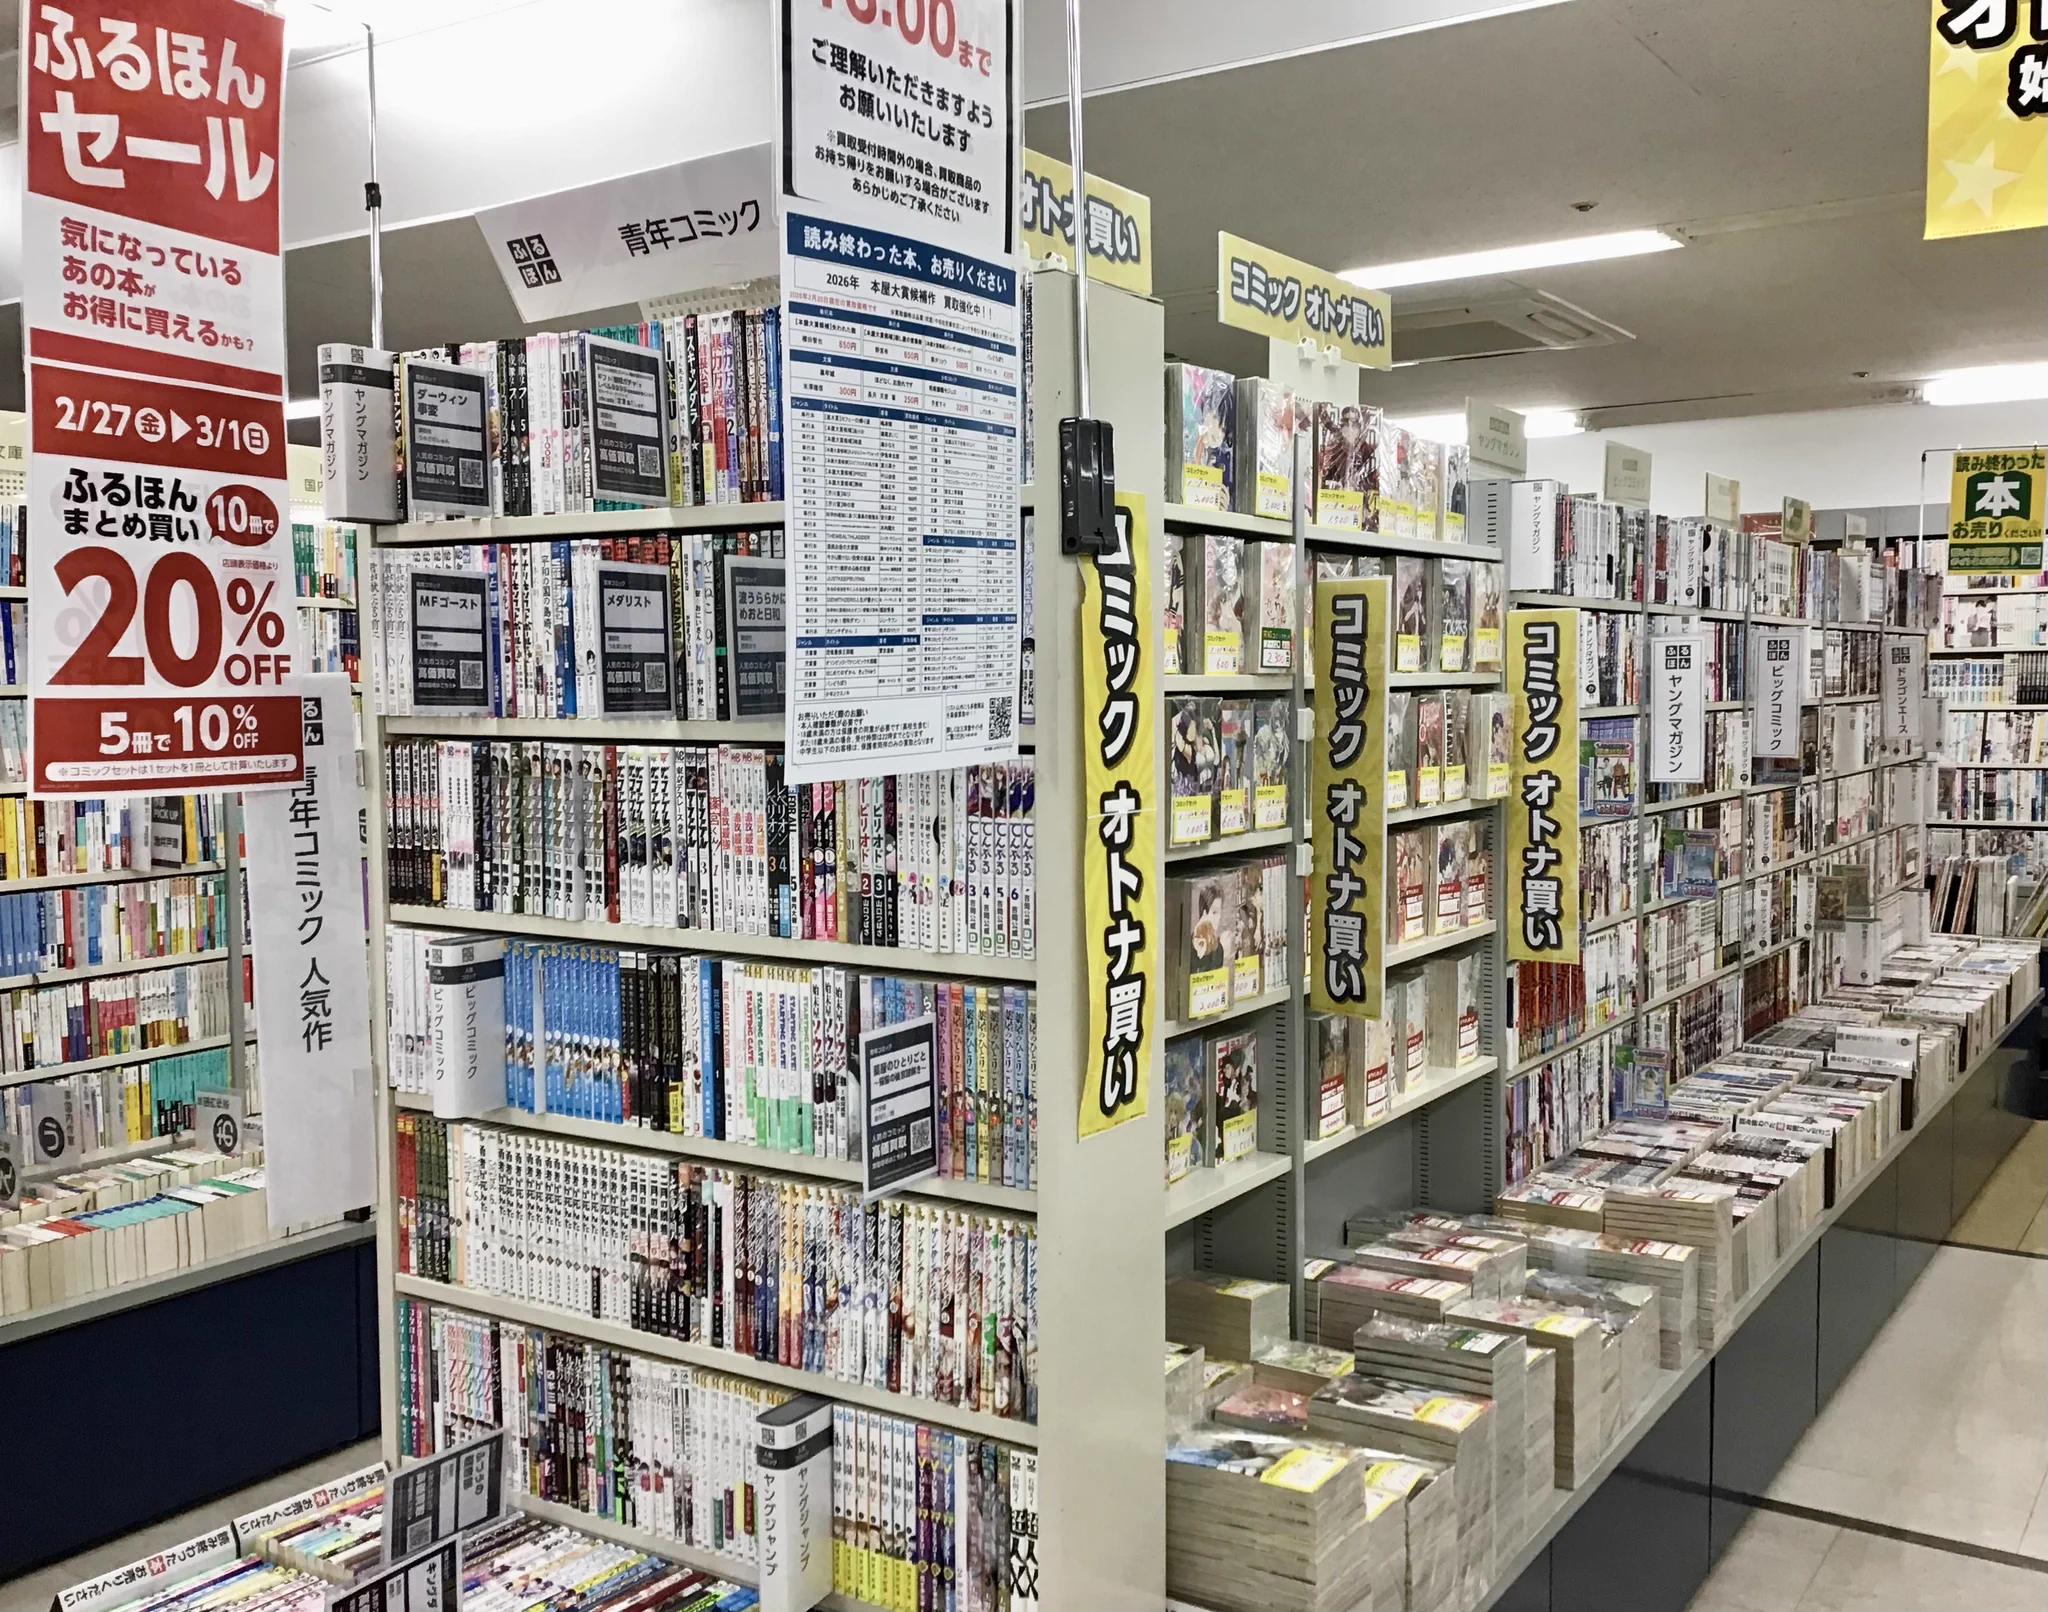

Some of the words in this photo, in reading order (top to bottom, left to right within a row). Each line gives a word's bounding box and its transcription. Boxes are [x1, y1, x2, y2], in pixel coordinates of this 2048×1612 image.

[34, 5, 265, 109] ふるほん
[812, 37, 993, 129] ご理解いただきますよう
[839, 83, 971, 152] お願いいたします
[39, 90, 275, 201] セール
[826, 129, 982, 193] ※買取受付時間外の場合、買取商品の
[814, 144, 989, 214] お持ち帰りをお願いする場合がございます
[852, 177, 960, 223] あらかじめご了承ください
[618, 199, 760, 257] 青年コミック
[60, 216, 242, 285] 気になっている
[803, 225, 1008, 293] 読み終わった本、お売りください
[62, 256, 156, 298] あの本が
[826, 273, 860, 289] 2026年
[870, 279, 936, 306] 本屋大賞候補作
[1231, 256, 1300, 322] コミック
[1306, 285, 1384, 347] オトナ買い
[418, 389, 467, 405] ダーウィン
[418, 402, 438, 417] 事変
[324, 388, 336, 480] ヤングマガジン
[355, 389, 369, 480] ヤングマガジン
[599, 438, 633, 450] 人気のコミック
[416, 452, 454, 462] 人気のコミック
[416, 461, 455, 476] 高価買取
[599, 448, 635, 464] 高価買取
[1955, 453, 2045, 473] 読み終わった
[62, 468, 198, 512] ふるほん
[1975, 476, 2020, 517] 本
[63, 509, 199, 542] まとめ買い
[212, 495, 275, 535] 10冊で
[1532, 495, 1541, 554] ヤングマガジン
[222, 558, 279, 571] 店頭表示価格より
[420, 595, 478, 610] MFゴースト
[607, 595, 651, 608] メダリスト
[740, 608, 780, 620] めおと日和
[705, 628, 714, 645] 9
[1097, 507, 1139, 769] コミック
[418, 667, 455, 679] 高価買取
[607, 671, 641, 683] 高価買取
[740, 672, 773, 685] 高価買取
[1329, 595, 1368, 770] コミック
[1524, 622, 1561, 765] コミック
[1770, 665, 1784, 751] ビッグコミック
[1897, 666, 1909, 735] ドラゴンエース
[1668, 675, 1683, 773] ヤングマガジン
[769, 856, 776, 871] 3
[779, 856, 787, 872] 4
[1523, 770, 1564, 951] オトナ買い
[791, 876, 797, 891] 5
[862, 880, 868, 890] 2
[876, 879, 882, 891] 3
[983, 887, 990, 899] 4
[997, 887, 1003, 898] 5
[1011, 888, 1018, 900] 6
[1327, 779, 1368, 1003] オトナ買い
[1100, 781, 1146, 1116] オトナ買い
[299, 956, 333, 1053] 人気作
[433, 987, 445, 1081] ビッグコミック
[465, 985, 478, 1080] ビッグコミック
[873, 1051, 926, 1076] 薬屋のひとりごと
[872, 1124, 905, 1143] 人気のコミック
[872, 1135, 907, 1159] 高価買取
[763, 1472, 780, 1576] ヤングジャンプ
[797, 1466, 810, 1573] ヤングジャンプ
